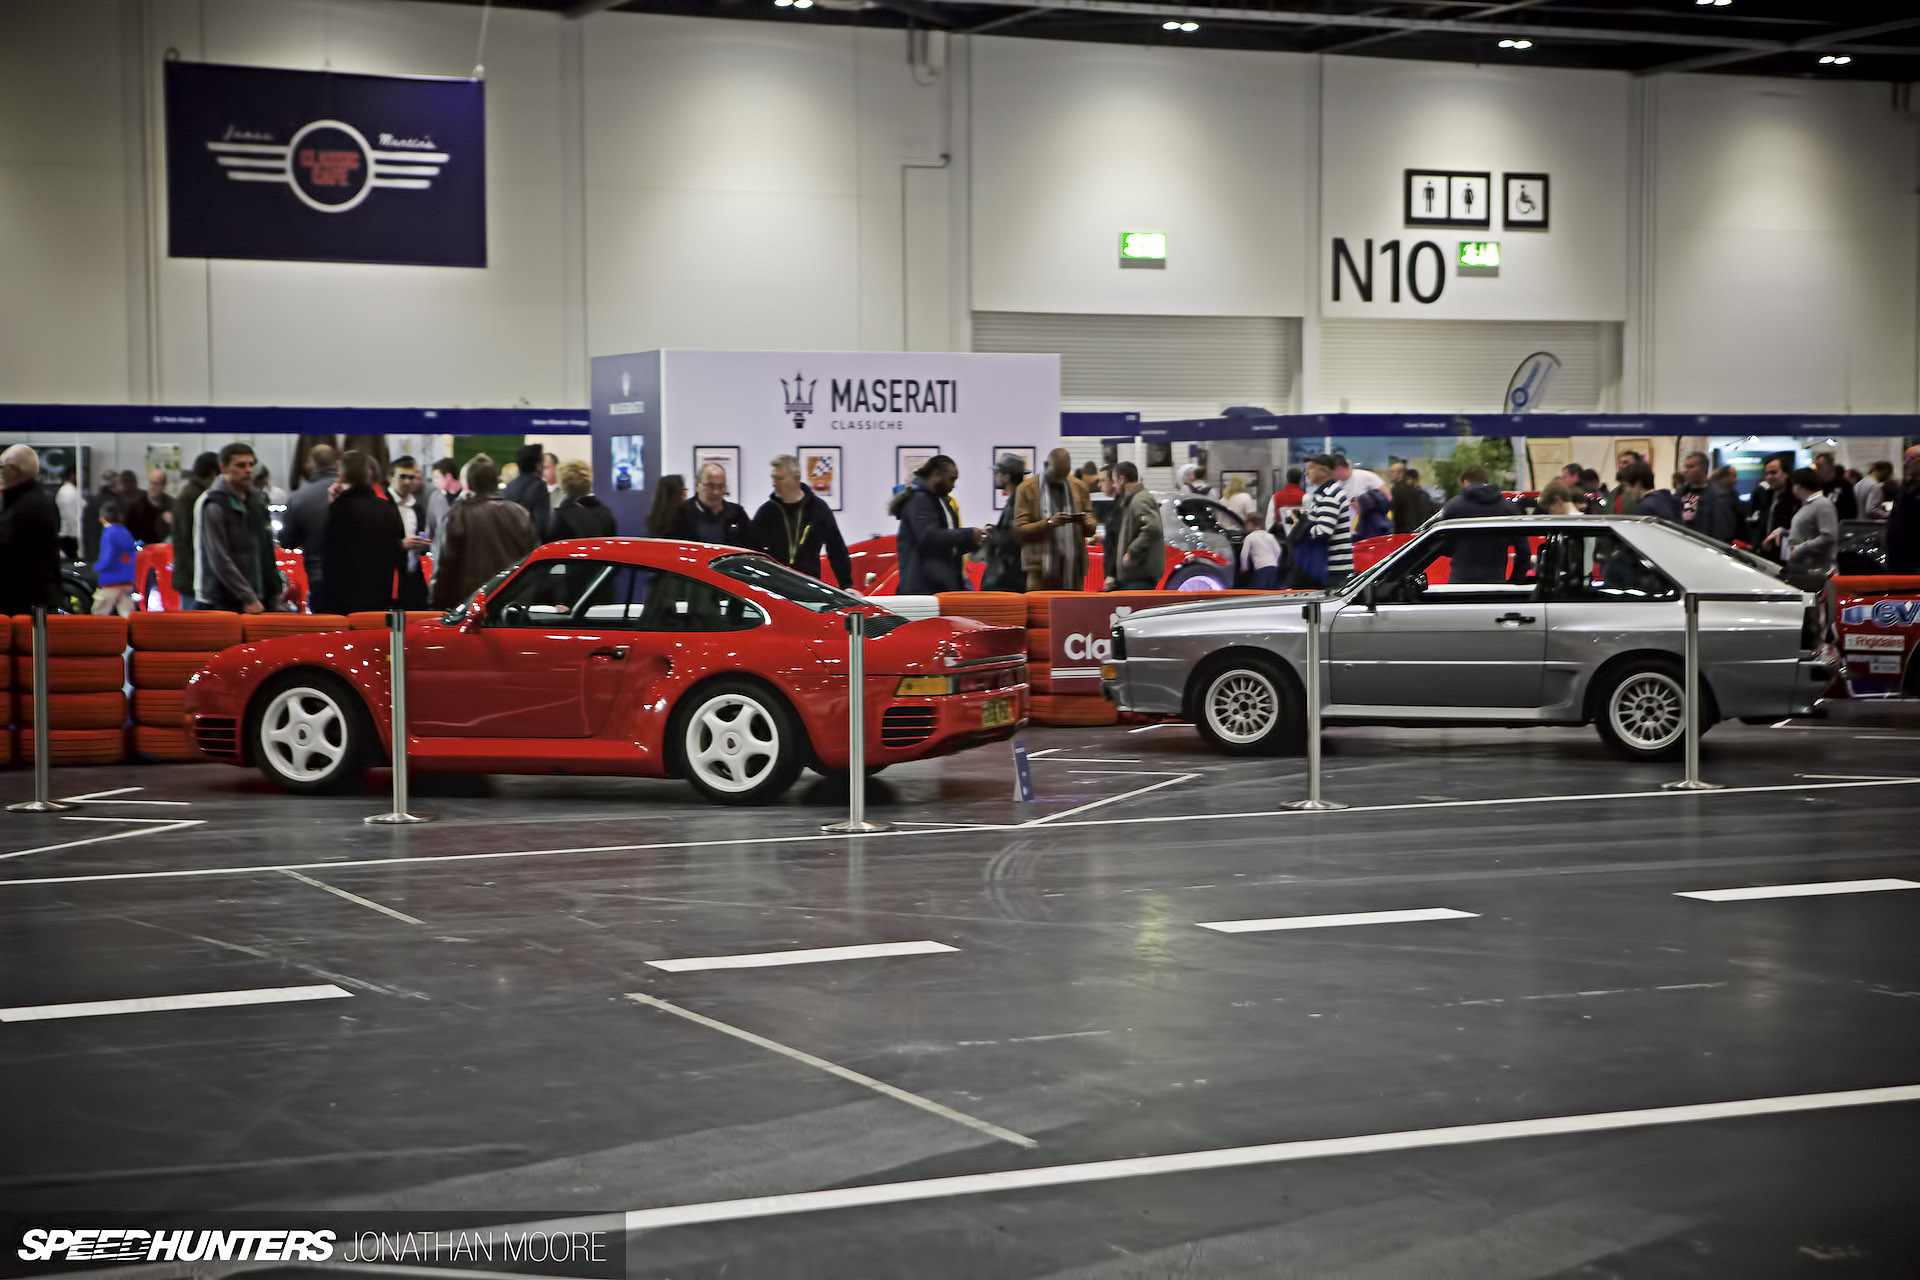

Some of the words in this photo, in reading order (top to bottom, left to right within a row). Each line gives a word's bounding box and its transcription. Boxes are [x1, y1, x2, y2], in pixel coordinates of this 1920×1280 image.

[1331, 237, 1446, 304] N10
[831, 378, 957, 413] MASERATI
[831, 420, 904, 430] CLASSICHE
